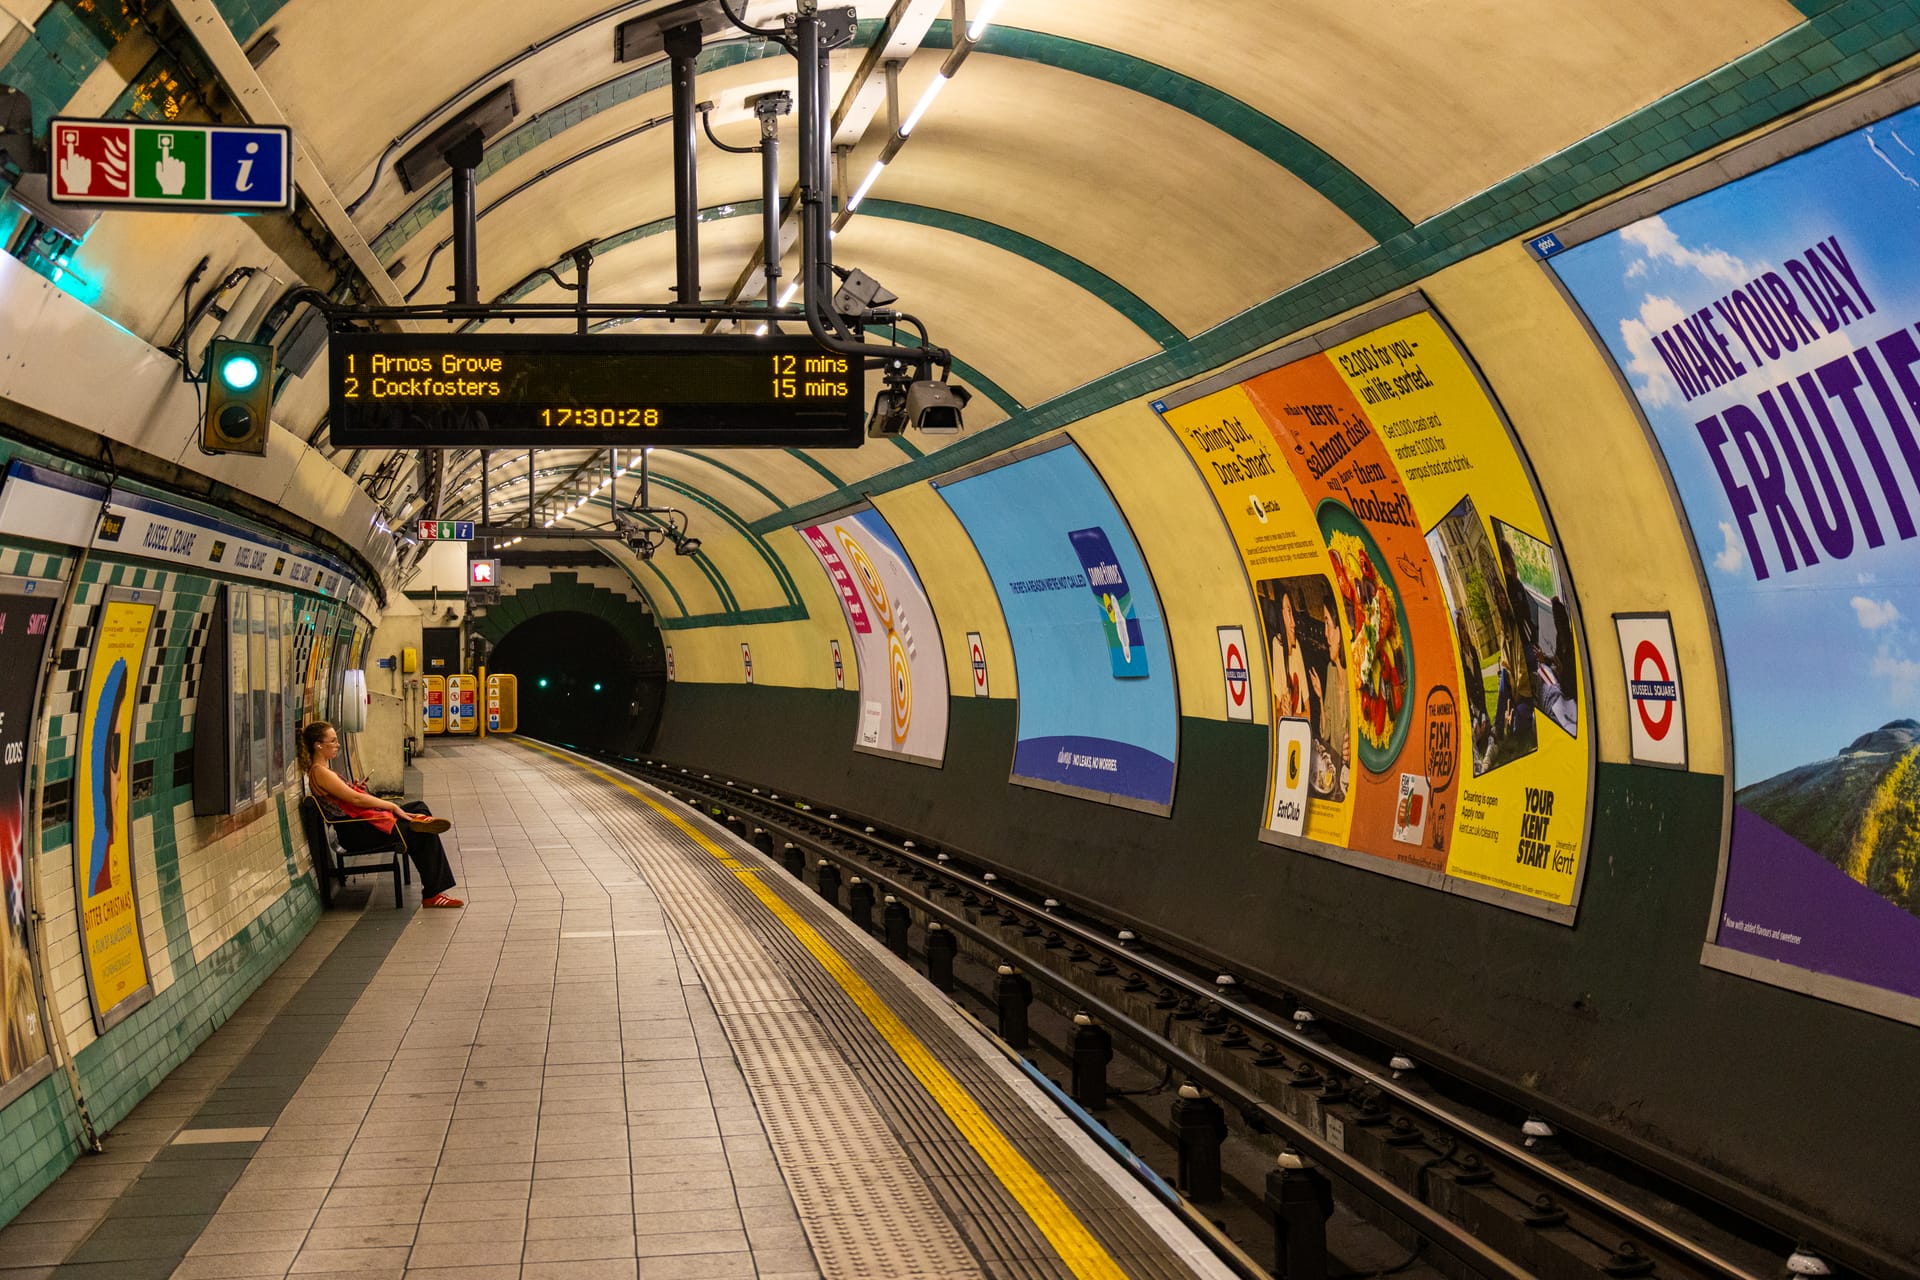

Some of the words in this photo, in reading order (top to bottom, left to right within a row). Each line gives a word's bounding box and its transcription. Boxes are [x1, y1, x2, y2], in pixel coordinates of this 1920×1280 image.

[1651, 307, 1747, 402] MAKE
[1713, 271, 1820, 368] YOUR
[1784, 235, 1876, 334] DAY
[348, 354, 355, 374] 1
[372, 354, 433, 374] Arnos
[442, 354, 503, 374] Grove
[772, 355, 796, 375] 12
[805, 355, 848, 373] mins
[1338, 347, 1379, 378] £2,000
[1370, 343, 1394, 367] for
[1387, 339, 1416, 368] you
[344, 377, 359, 398] 2
[372, 377, 501, 398] Cockfosters
[772, 378, 796, 398] 15
[805, 379, 848, 396] mins
[1360, 379, 1382, 405] uni
[1371, 376, 1401, 401] life,
[1392, 364, 1434, 395] sorted.
[541, 408, 659, 427] 17:30:28
[1283, 403, 1303, 417] what
[1300, 404, 1340, 427] new
[1306, 431, 1352, 480] salmon
[1342, 413, 1371, 447] dish
[1211, 461, 1245, 485] Done
[1326, 477, 1342, 491] will
[1339, 470, 1354, 485] have
[1352, 460, 1387, 485] them
[1344, 487, 1416, 528] hooked?
[27, 613, 49, 635] SMITH
[1631, 684, 1653, 696] RUSSELL
[1653, 684, 1676, 697] SQUARE
[1429, 721, 1452, 752] FISH
[1276, 799, 1300, 821] EatClub
[1524, 787, 1555, 817] YOUR
[1520, 812, 1550, 842] KENT
[1516, 838, 1551, 869] START
[1551, 848, 1575, 875] Kent
[102, 890, 132, 922] CHRISTMAS
